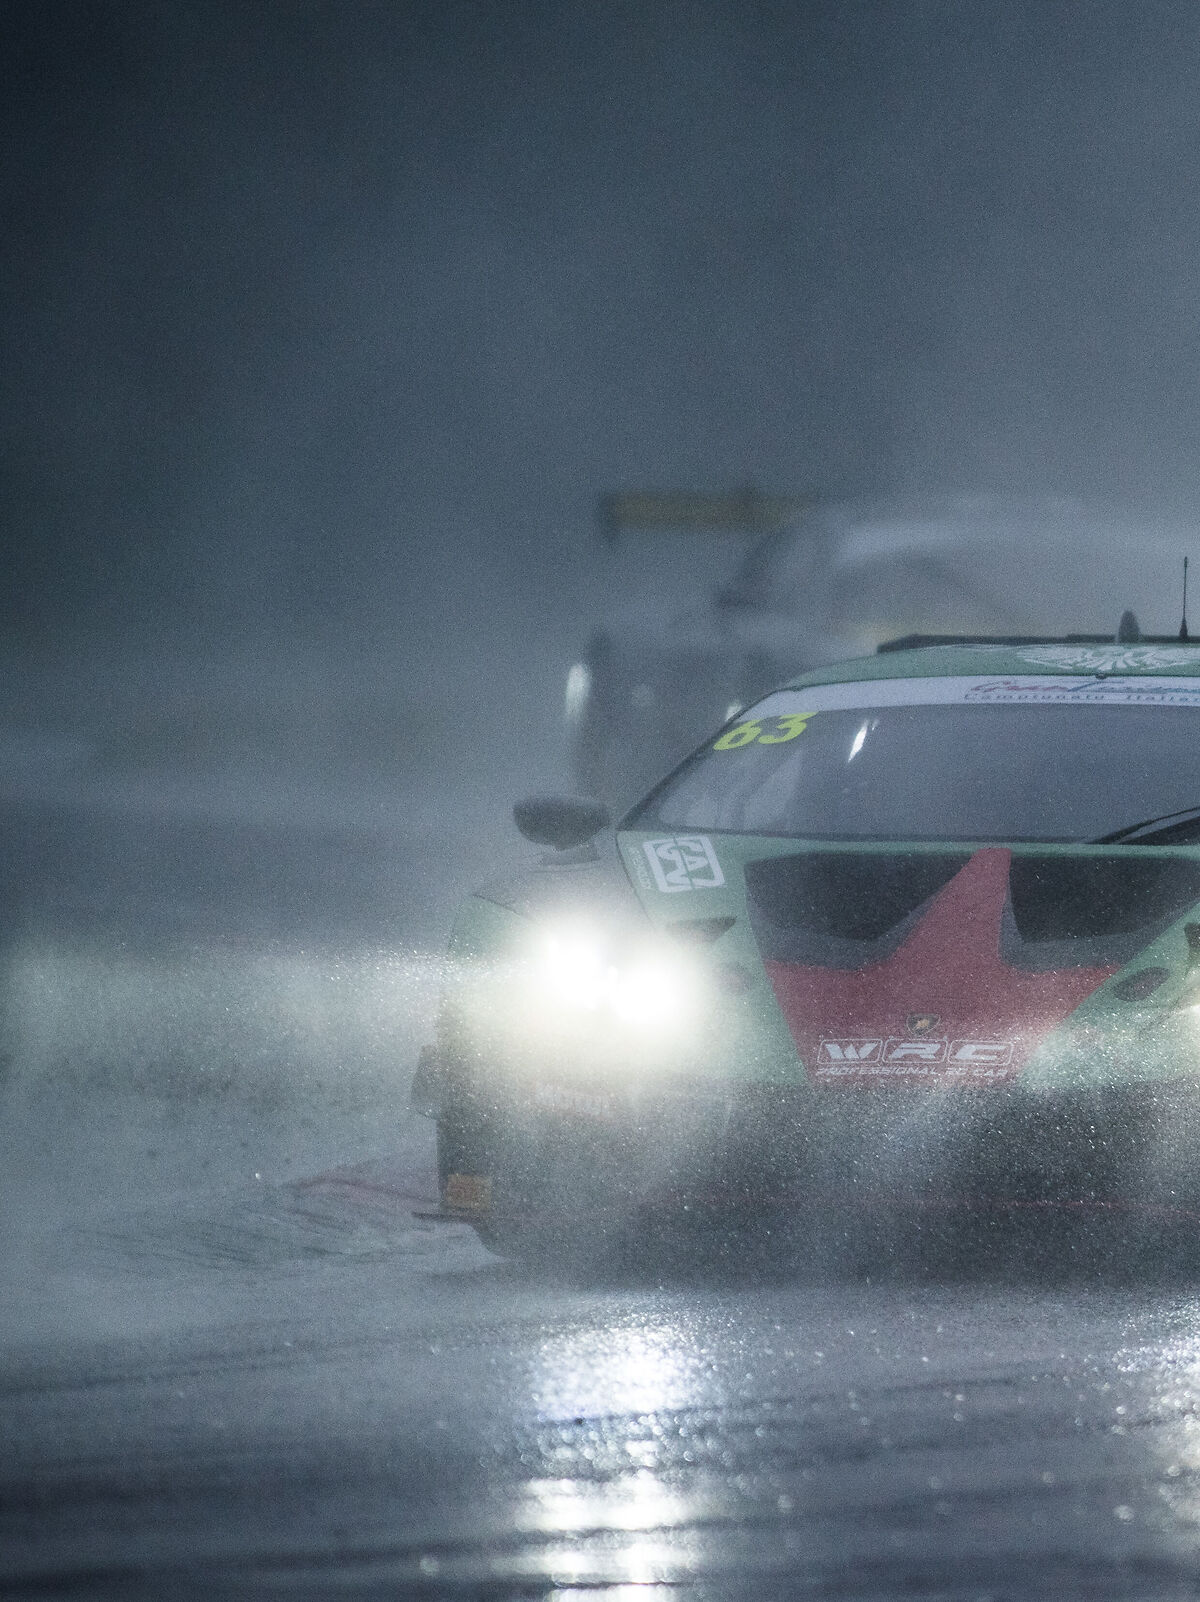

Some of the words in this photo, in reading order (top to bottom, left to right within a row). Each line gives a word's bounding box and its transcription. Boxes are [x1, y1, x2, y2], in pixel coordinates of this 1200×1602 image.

[713, 711, 820, 751] 63
[815, 1066, 939, 1077] PROFESSIONAL
[973, 1068, 1009, 1079] CAR
